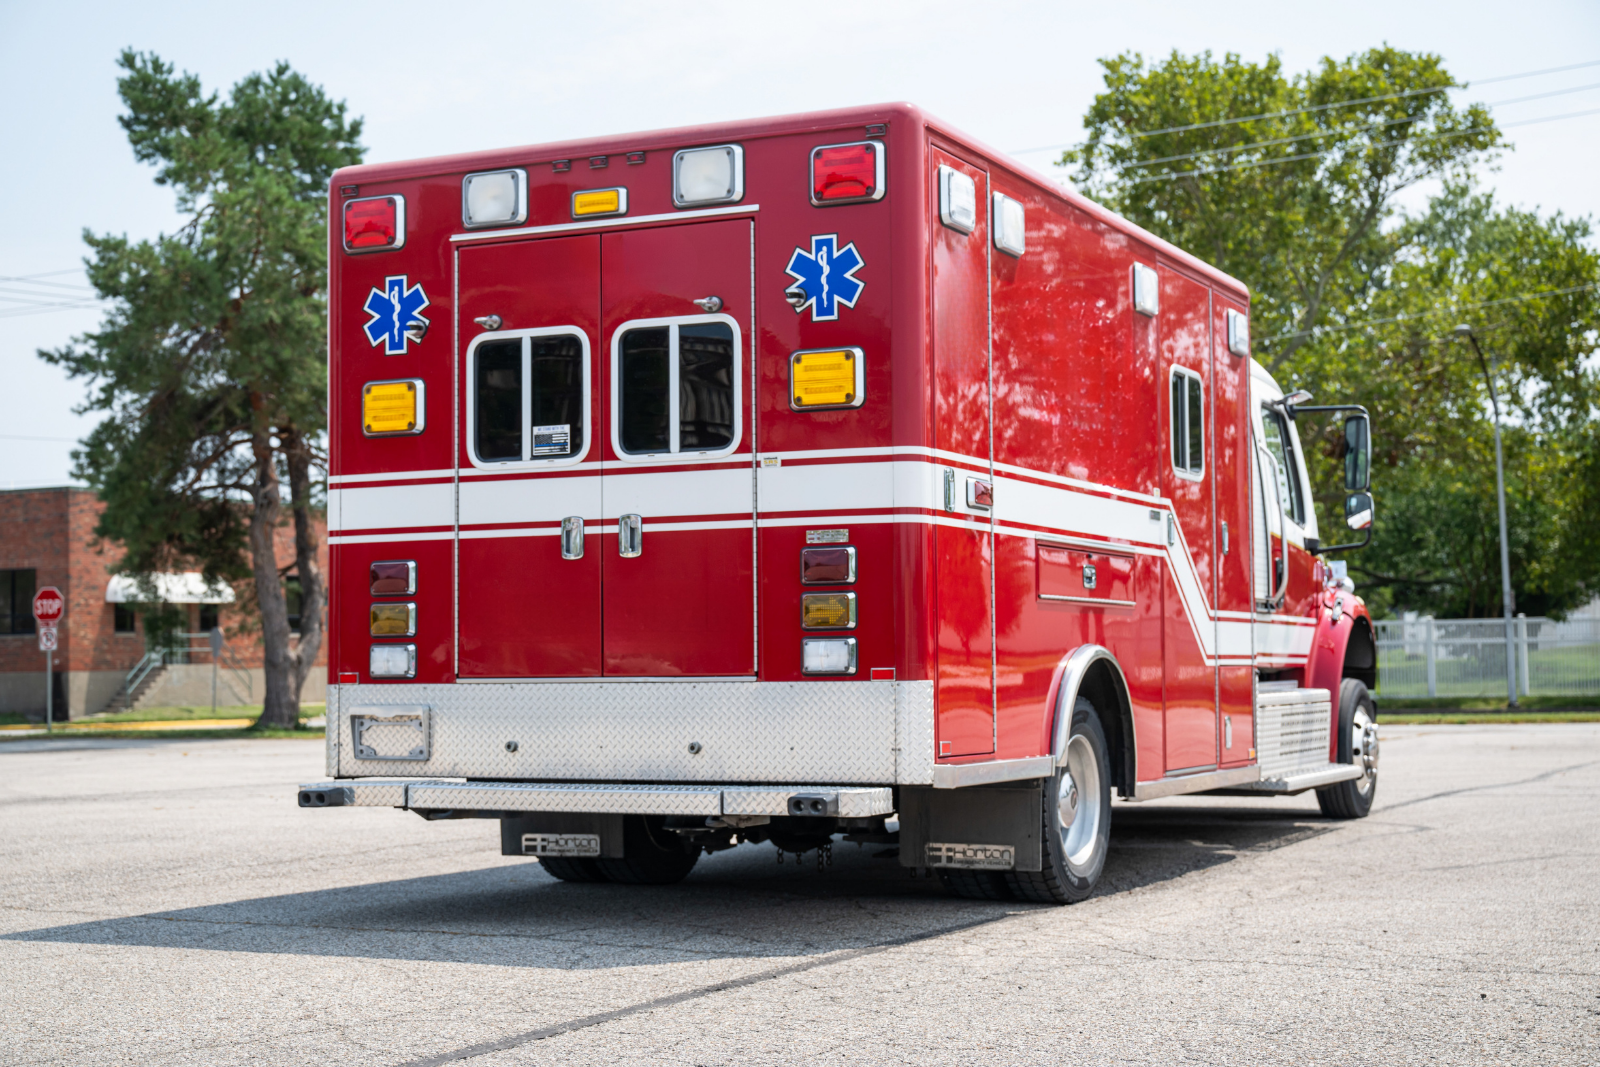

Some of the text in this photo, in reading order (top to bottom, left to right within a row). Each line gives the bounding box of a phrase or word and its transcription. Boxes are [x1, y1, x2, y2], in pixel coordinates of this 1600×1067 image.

[36, 598, 62, 615] STOP
[548, 836, 598, 847] Horton
[954, 847, 1012, 859] Horton
